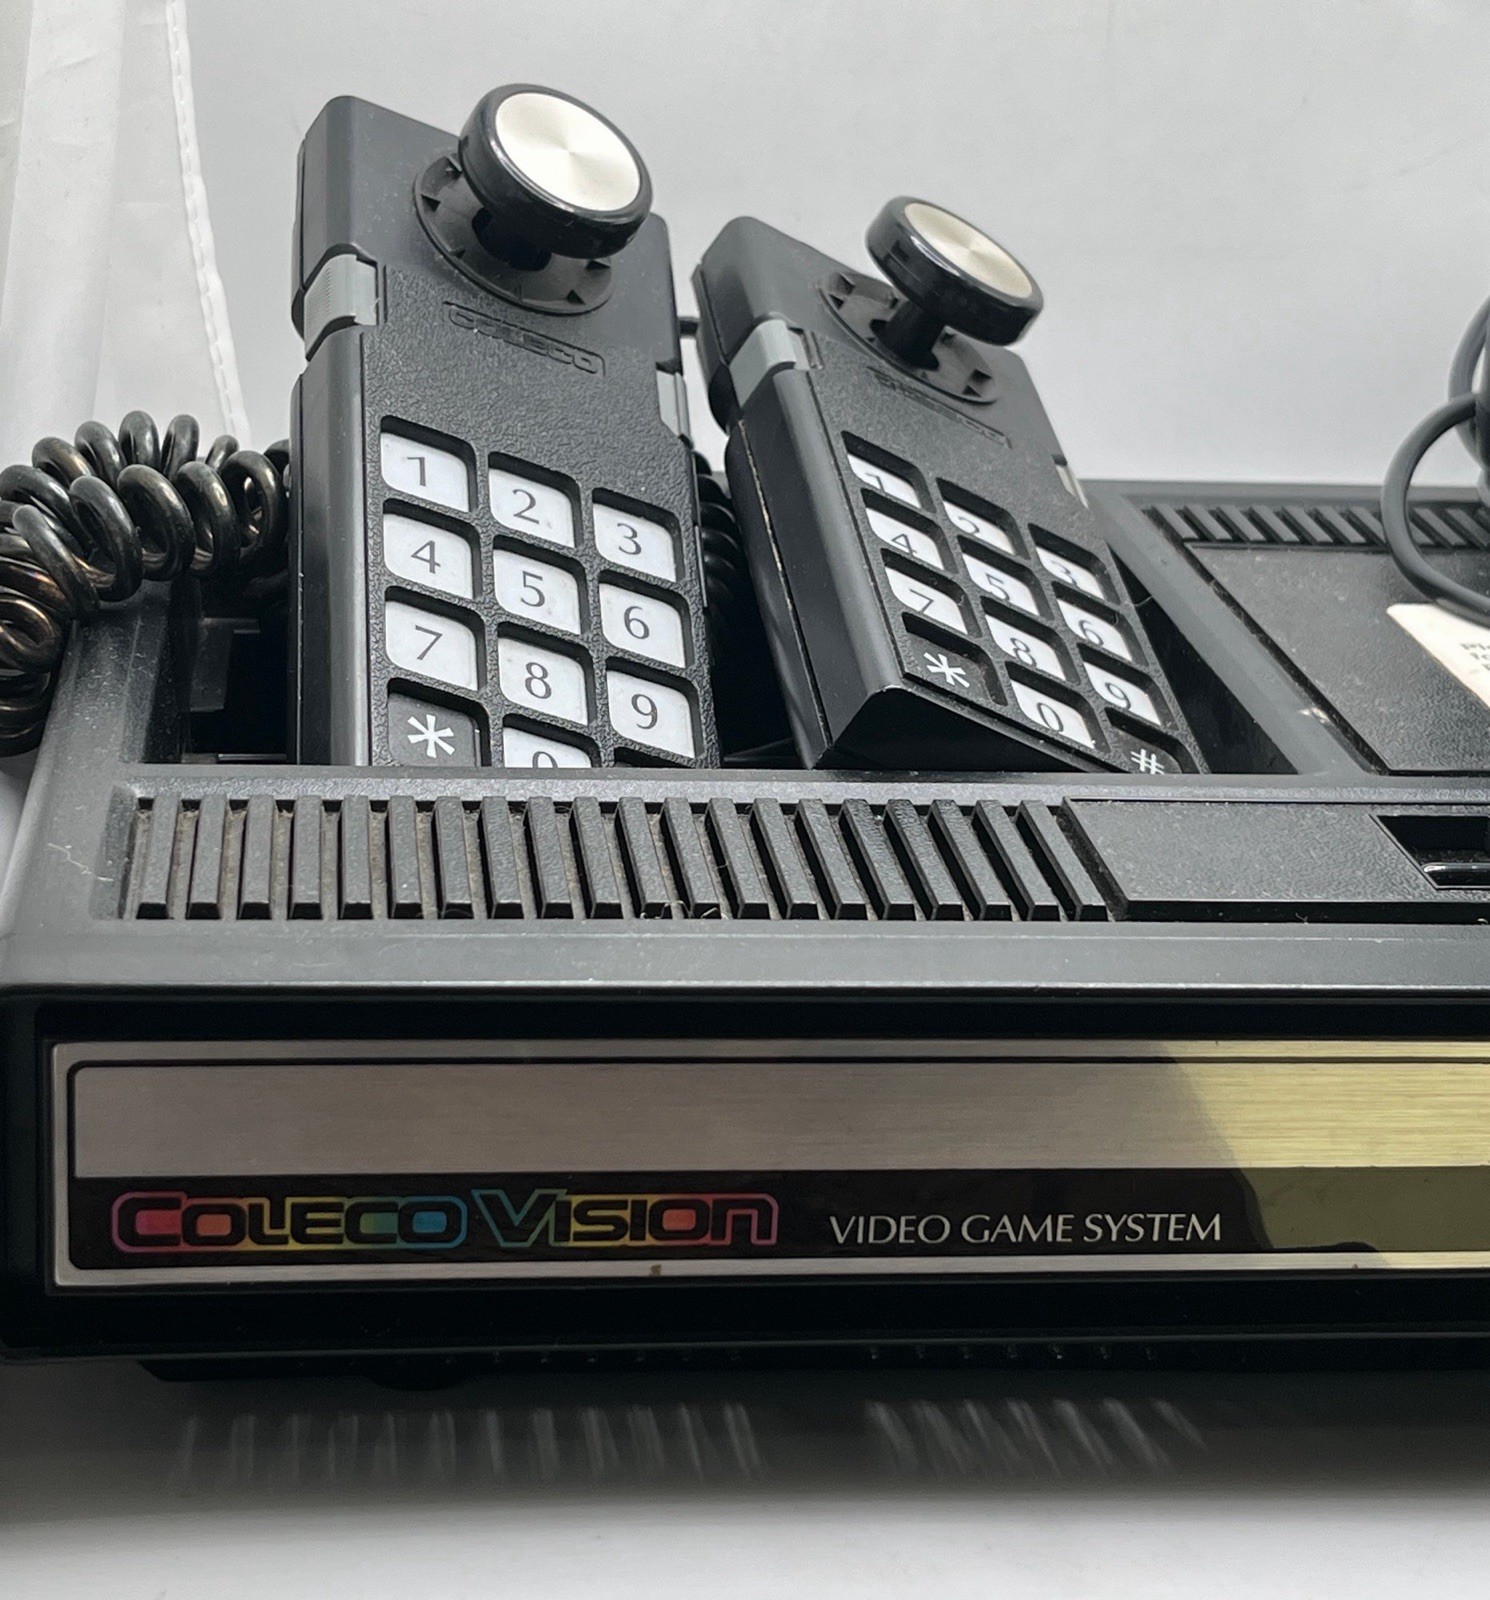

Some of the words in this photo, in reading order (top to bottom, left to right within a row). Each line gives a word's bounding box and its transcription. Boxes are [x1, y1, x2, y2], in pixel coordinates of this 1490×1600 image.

[406, 455, 428, 488] 1
[512, 488, 541, 525] 2
[616, 522, 643, 556] 3
[410, 540, 442, 575] 4
[520, 570, 547, 608] 5
[623, 605, 650, 641] 6
[891, 533, 918, 558] 4
[986, 573, 1011, 603] 5
[1078, 618, 1105, 647] 6
[413, 624, 443, 662] 7
[523, 661, 553, 700] 8
[630, 693, 659, 731] 9
[1010, 637, 1038, 669] 8
[1105, 682, 1132, 711] 9
[829, 1215, 951, 1245] VIDEO
[961, 1213, 1075, 1244] GAME
[1083, 1212, 1222, 1242] SYSTEM
